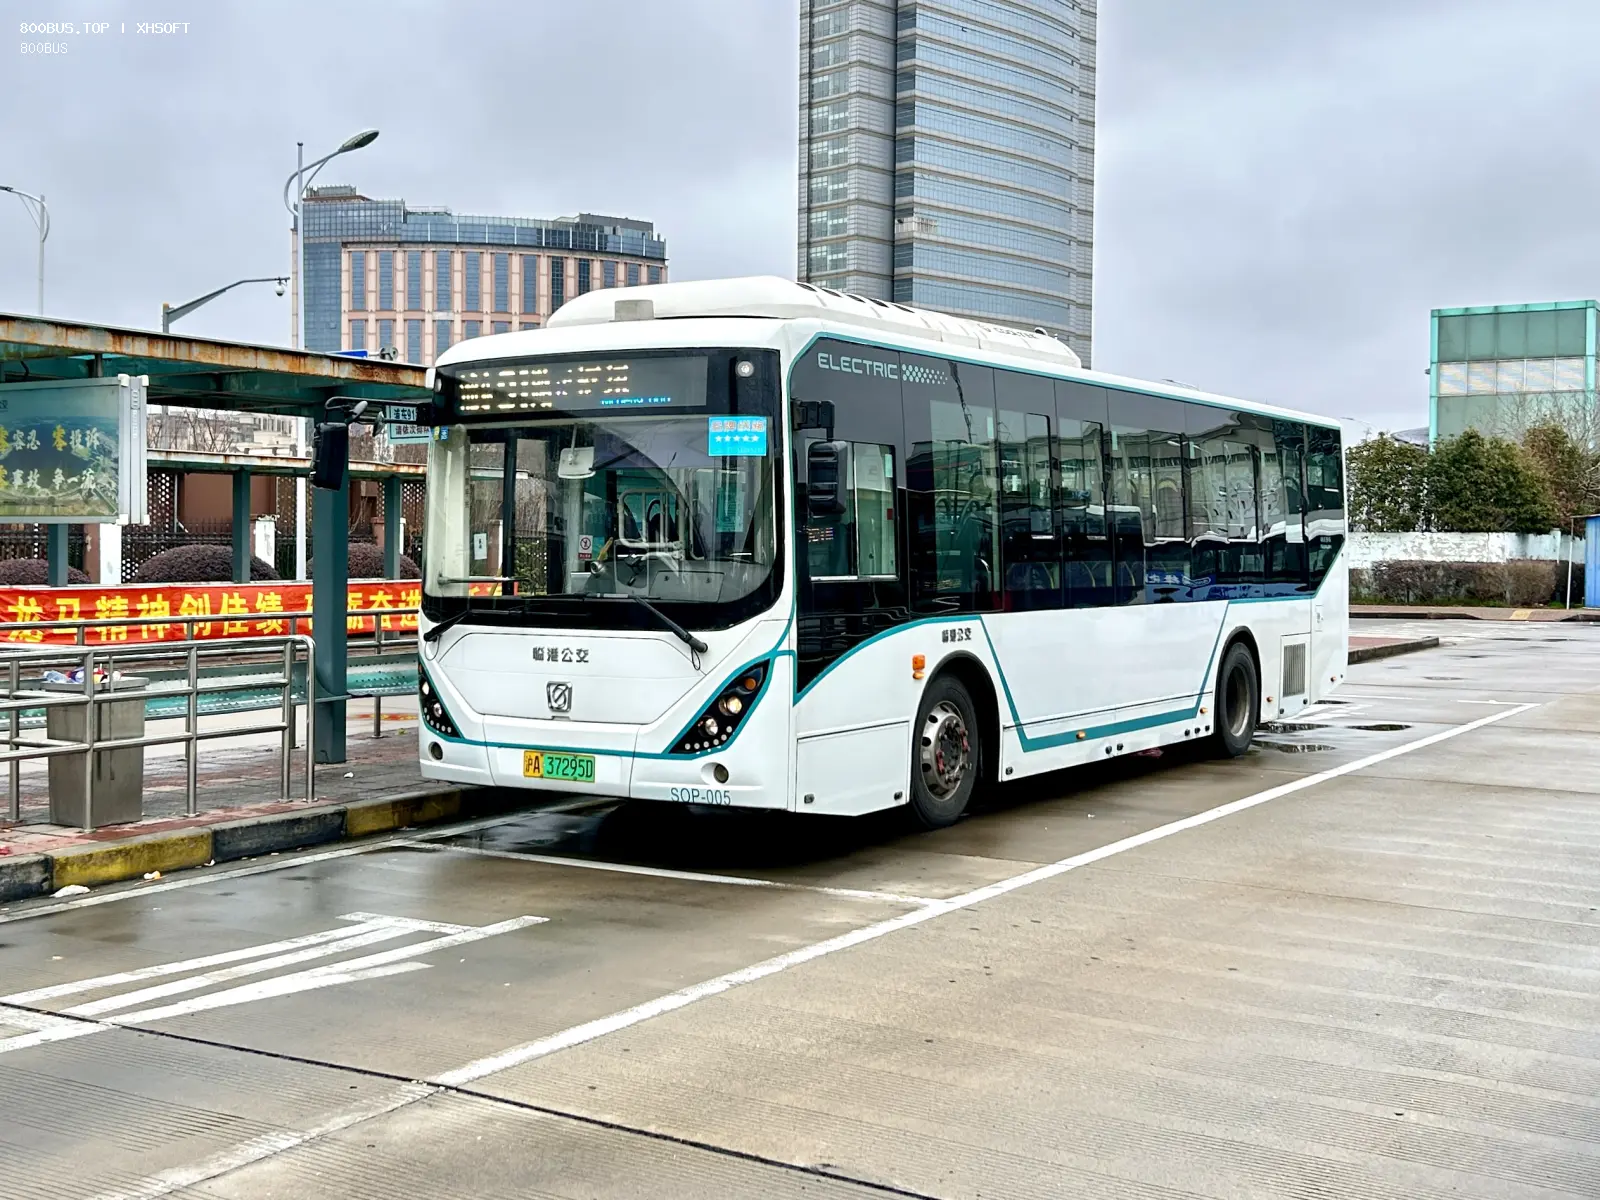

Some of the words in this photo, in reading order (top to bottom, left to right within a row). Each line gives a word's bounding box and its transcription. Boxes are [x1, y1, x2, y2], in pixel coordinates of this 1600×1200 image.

[817, 352, 899, 380] ELECTRIC
[532, 646, 590, 664] 临港公交
